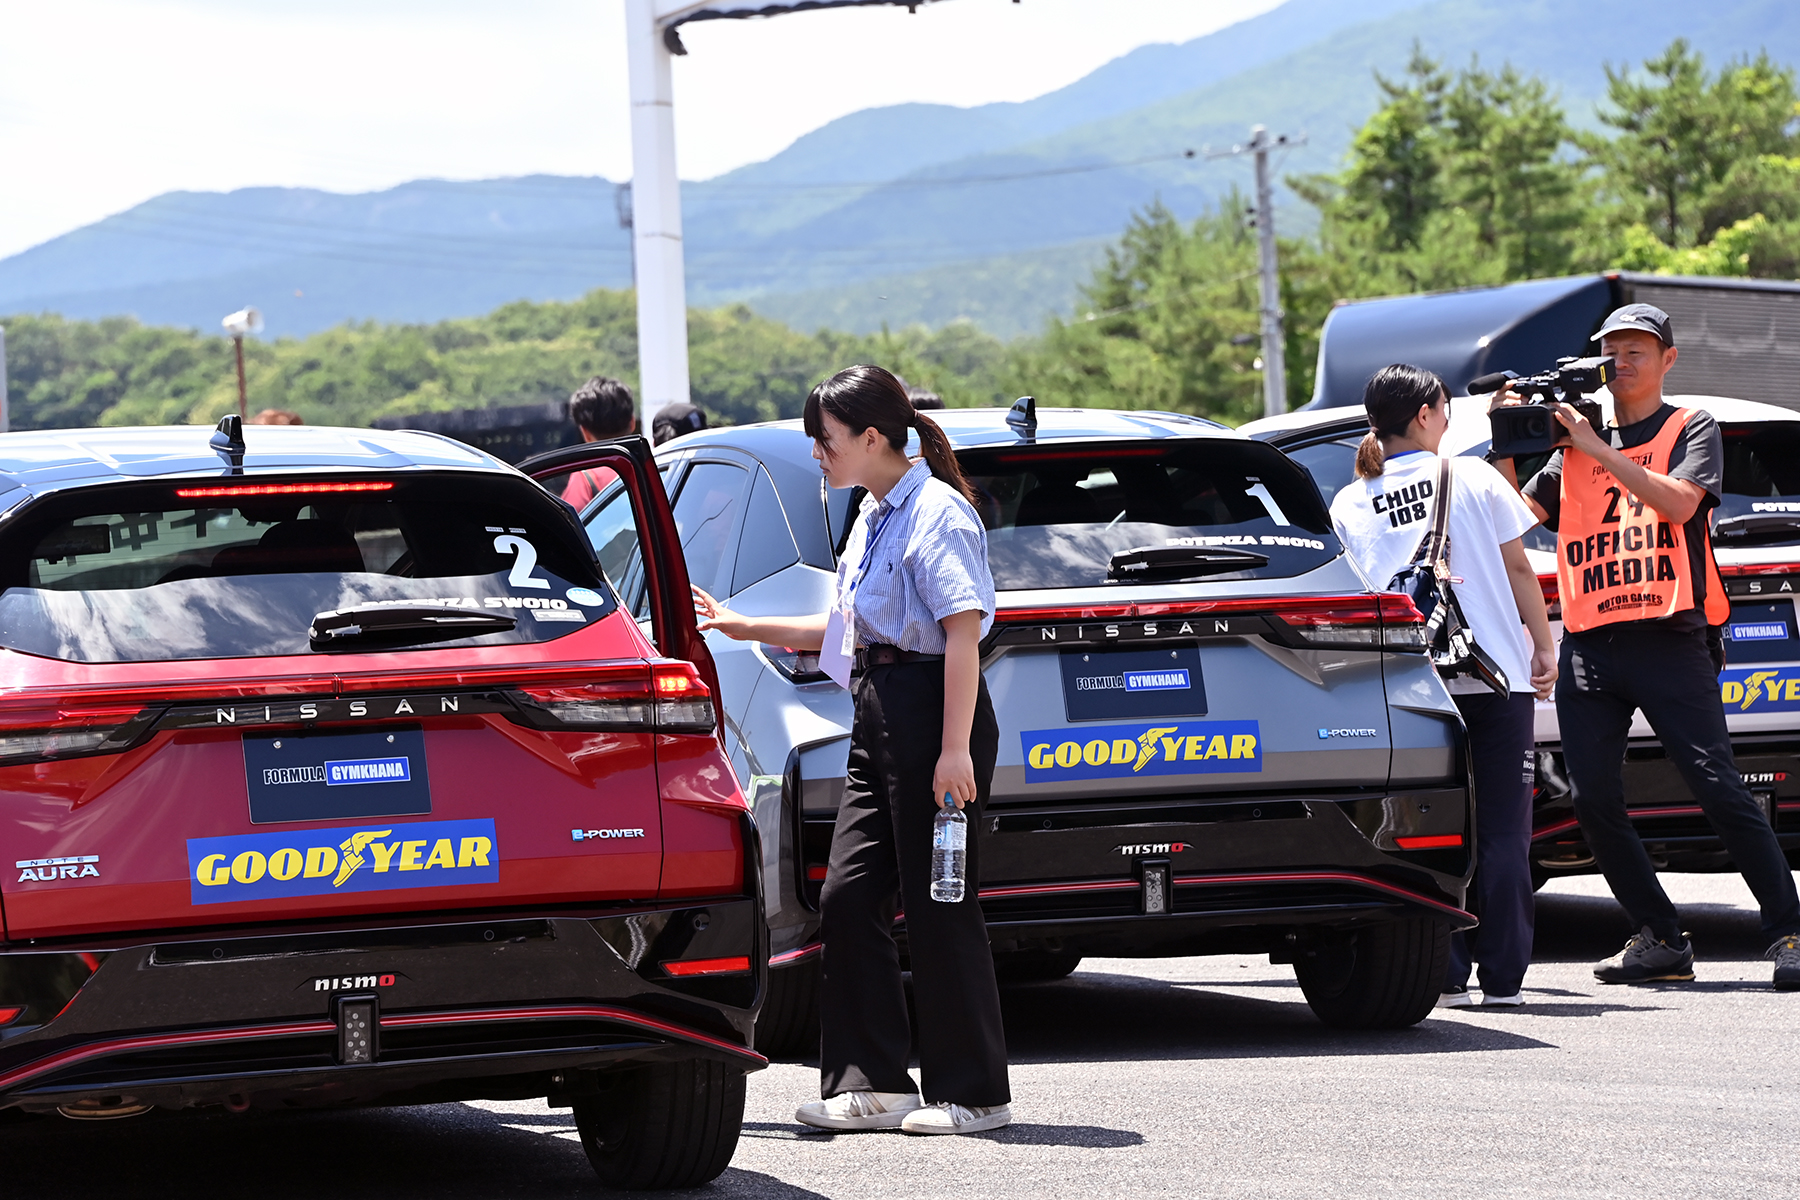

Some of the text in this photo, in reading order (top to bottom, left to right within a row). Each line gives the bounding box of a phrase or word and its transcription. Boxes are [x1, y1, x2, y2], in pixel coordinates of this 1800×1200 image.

[1245, 484, 1290, 526] 1
[1389, 502, 1427, 528] 108
[1166, 537, 1258, 546] POTENZA
[493, 534, 551, 590] 2
[1583, 555, 1676, 594] MEDIA
[1597, 595, 1628, 613] MOTOR
[1630, 593, 1663, 605] GAMES
[1041, 620, 1229, 641] NISSAN
[1734, 625, 1784, 638] GYMKHANA
[1076, 673, 1186, 690] FORMULA GYMKHANA
[216, 697, 460, 723] NISSAN
[1318, 728, 1377, 739] e-POWER
[263, 762, 405, 785] FORMULA GYMKHANA
[571, 828, 645, 841] e-POWER
[30, 857, 84, 866] NOTE
[17, 864, 100, 882] AURA
